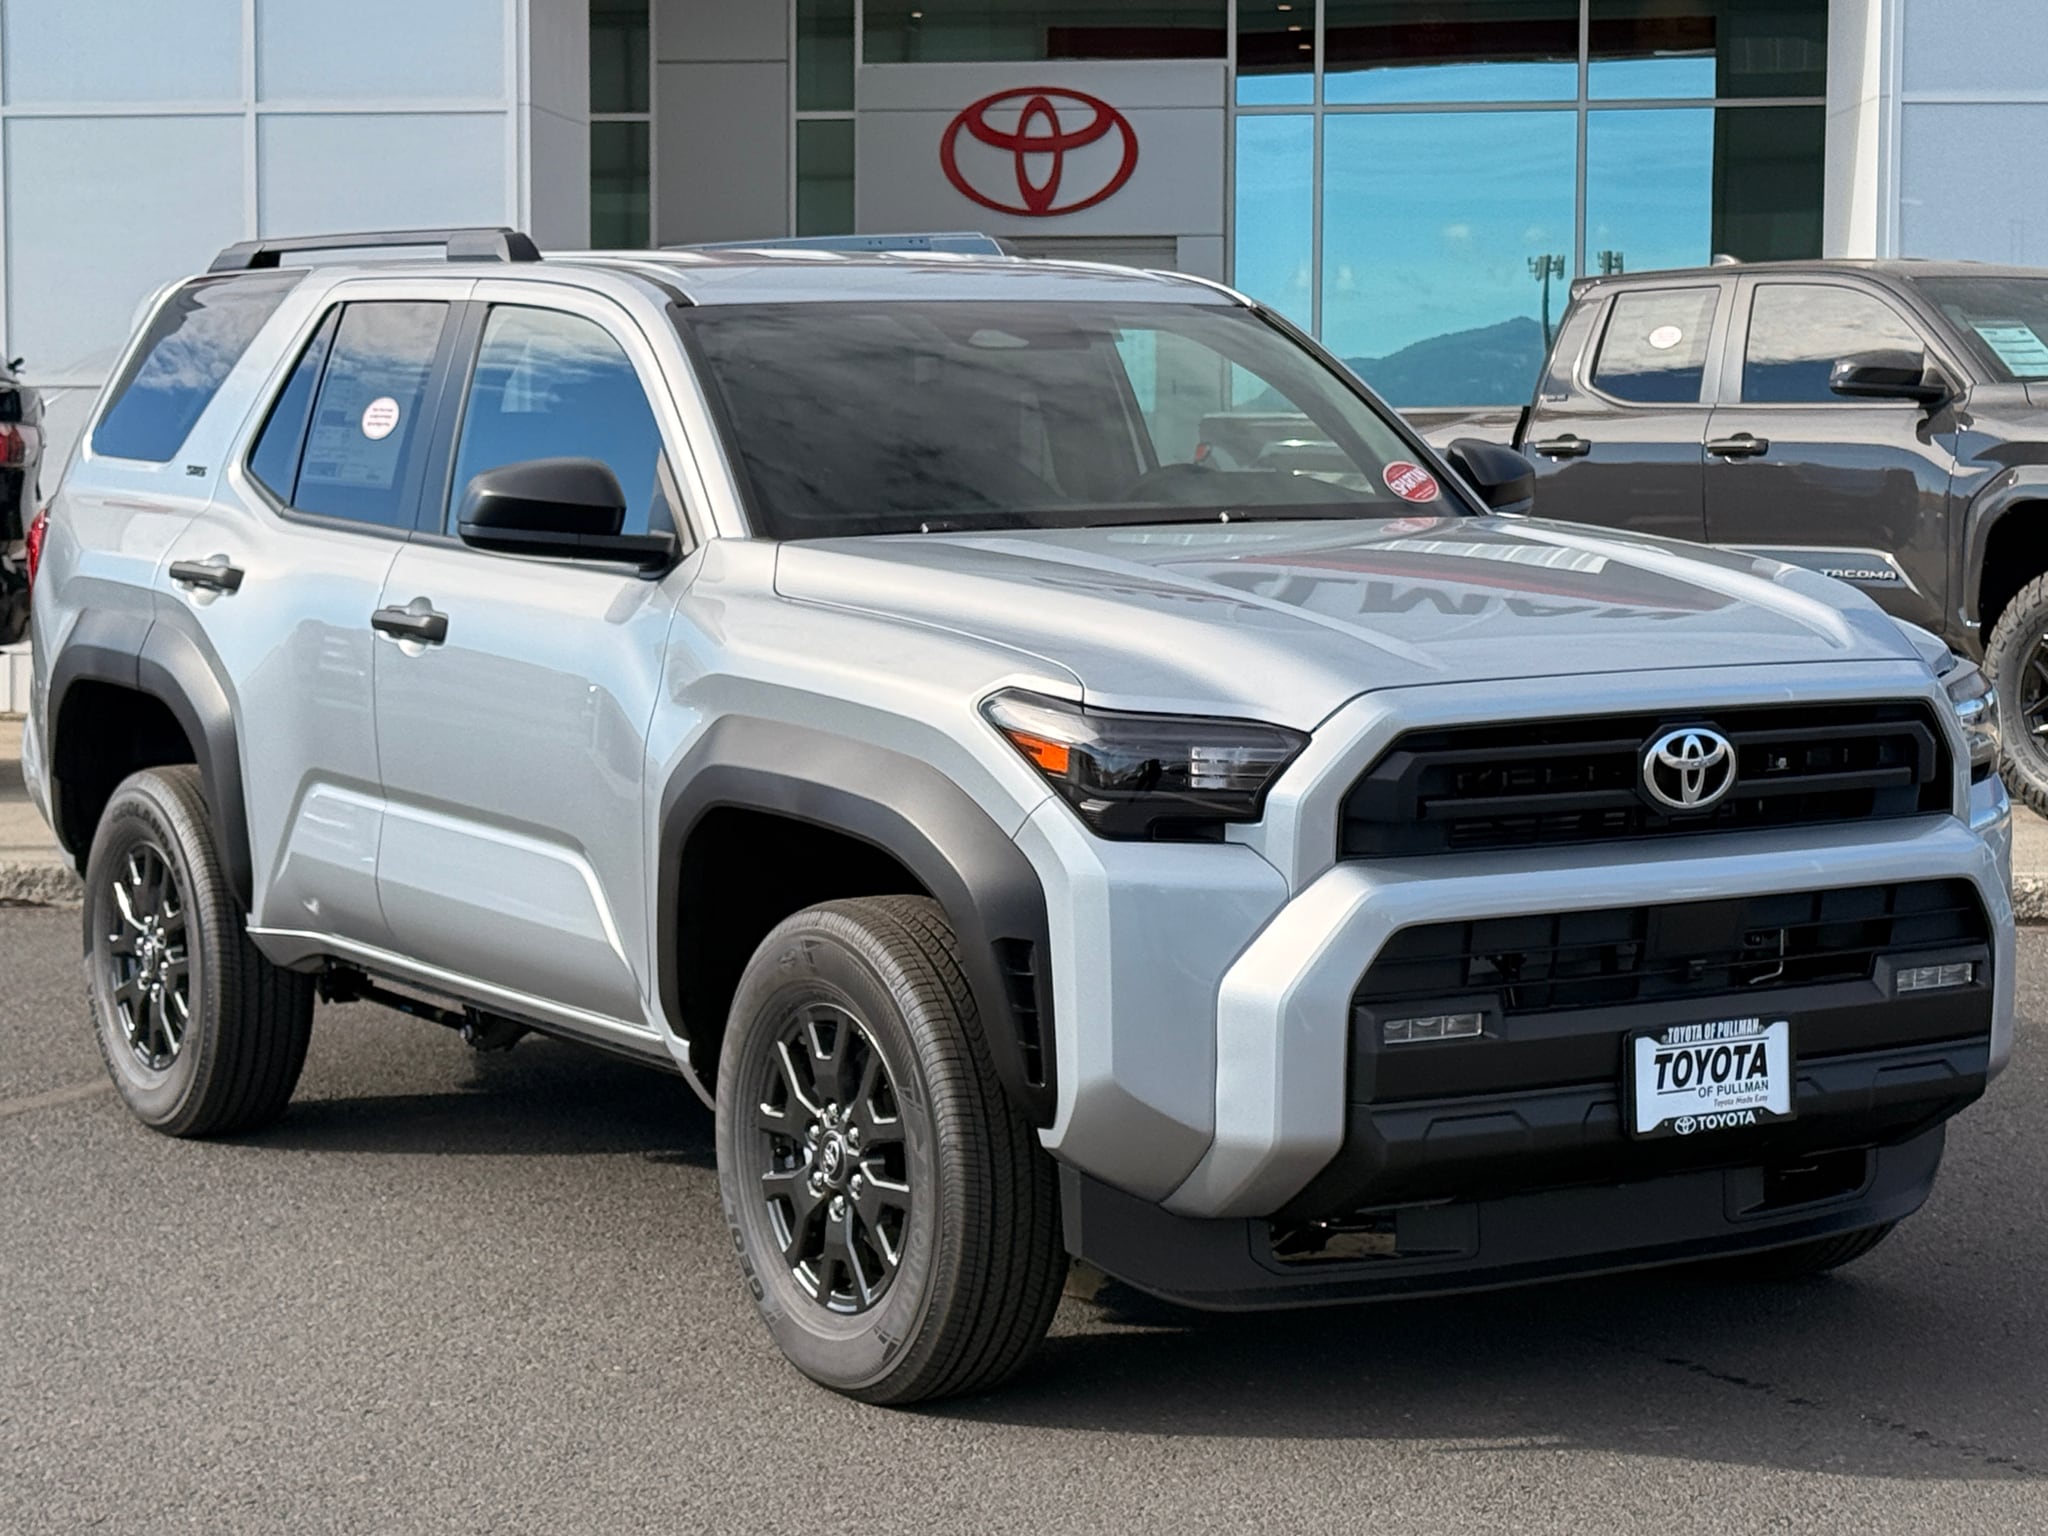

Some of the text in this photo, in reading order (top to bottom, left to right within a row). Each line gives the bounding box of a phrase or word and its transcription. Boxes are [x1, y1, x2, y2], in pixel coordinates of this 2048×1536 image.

[1820, 568, 1897, 579] TACOMA
[1668, 1018, 1759, 1043] TOYOTA OF PULLMAN
[1655, 1043, 1768, 1090] TOYOTA
[1698, 1080, 1769, 1098] OF PULLMAN
[1698, 1110, 1757, 1130] TOYOTA
